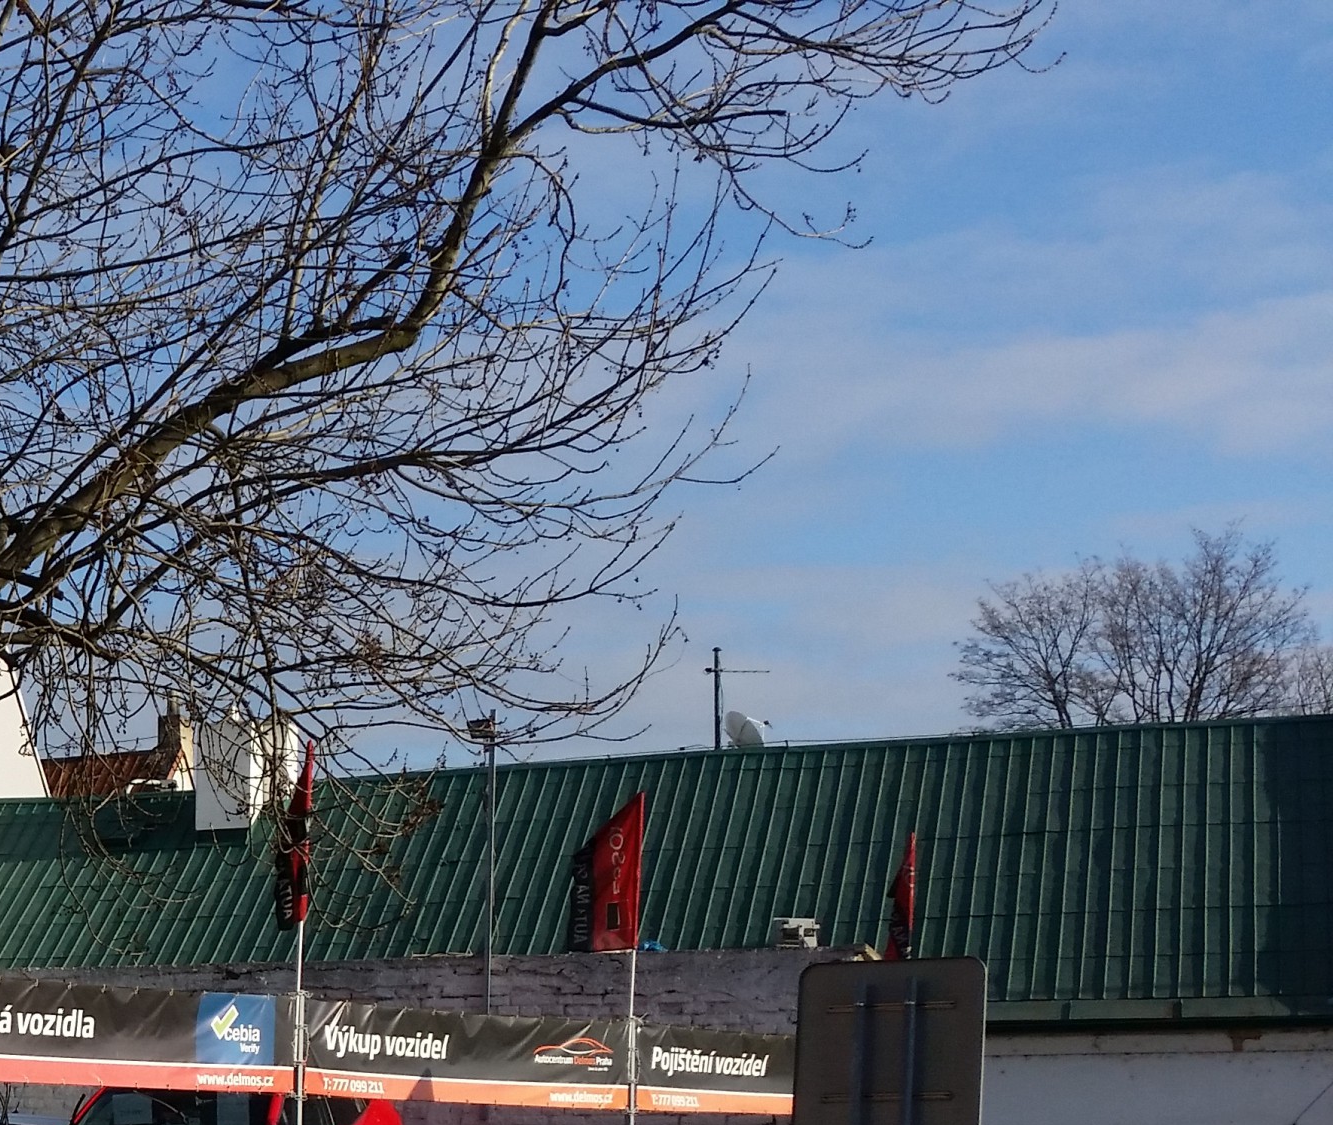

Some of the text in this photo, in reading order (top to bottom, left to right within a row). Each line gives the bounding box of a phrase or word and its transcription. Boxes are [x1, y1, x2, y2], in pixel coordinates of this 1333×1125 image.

[17, 1008, 95, 1039] vozidla
[224, 1024, 261, 1042] cebia
[240, 1043, 260, 1055] Verify
[324, 1024, 450, 1061] Výkup vozidel
[651, 1046, 770, 1077] Pojištění vozidel
[196, 1072, 274, 1087] www.delmos.cz
[322, 1076, 385, 1094] T: 777 099 211
[549, 1091, 613, 1104] www.delmos.cz
